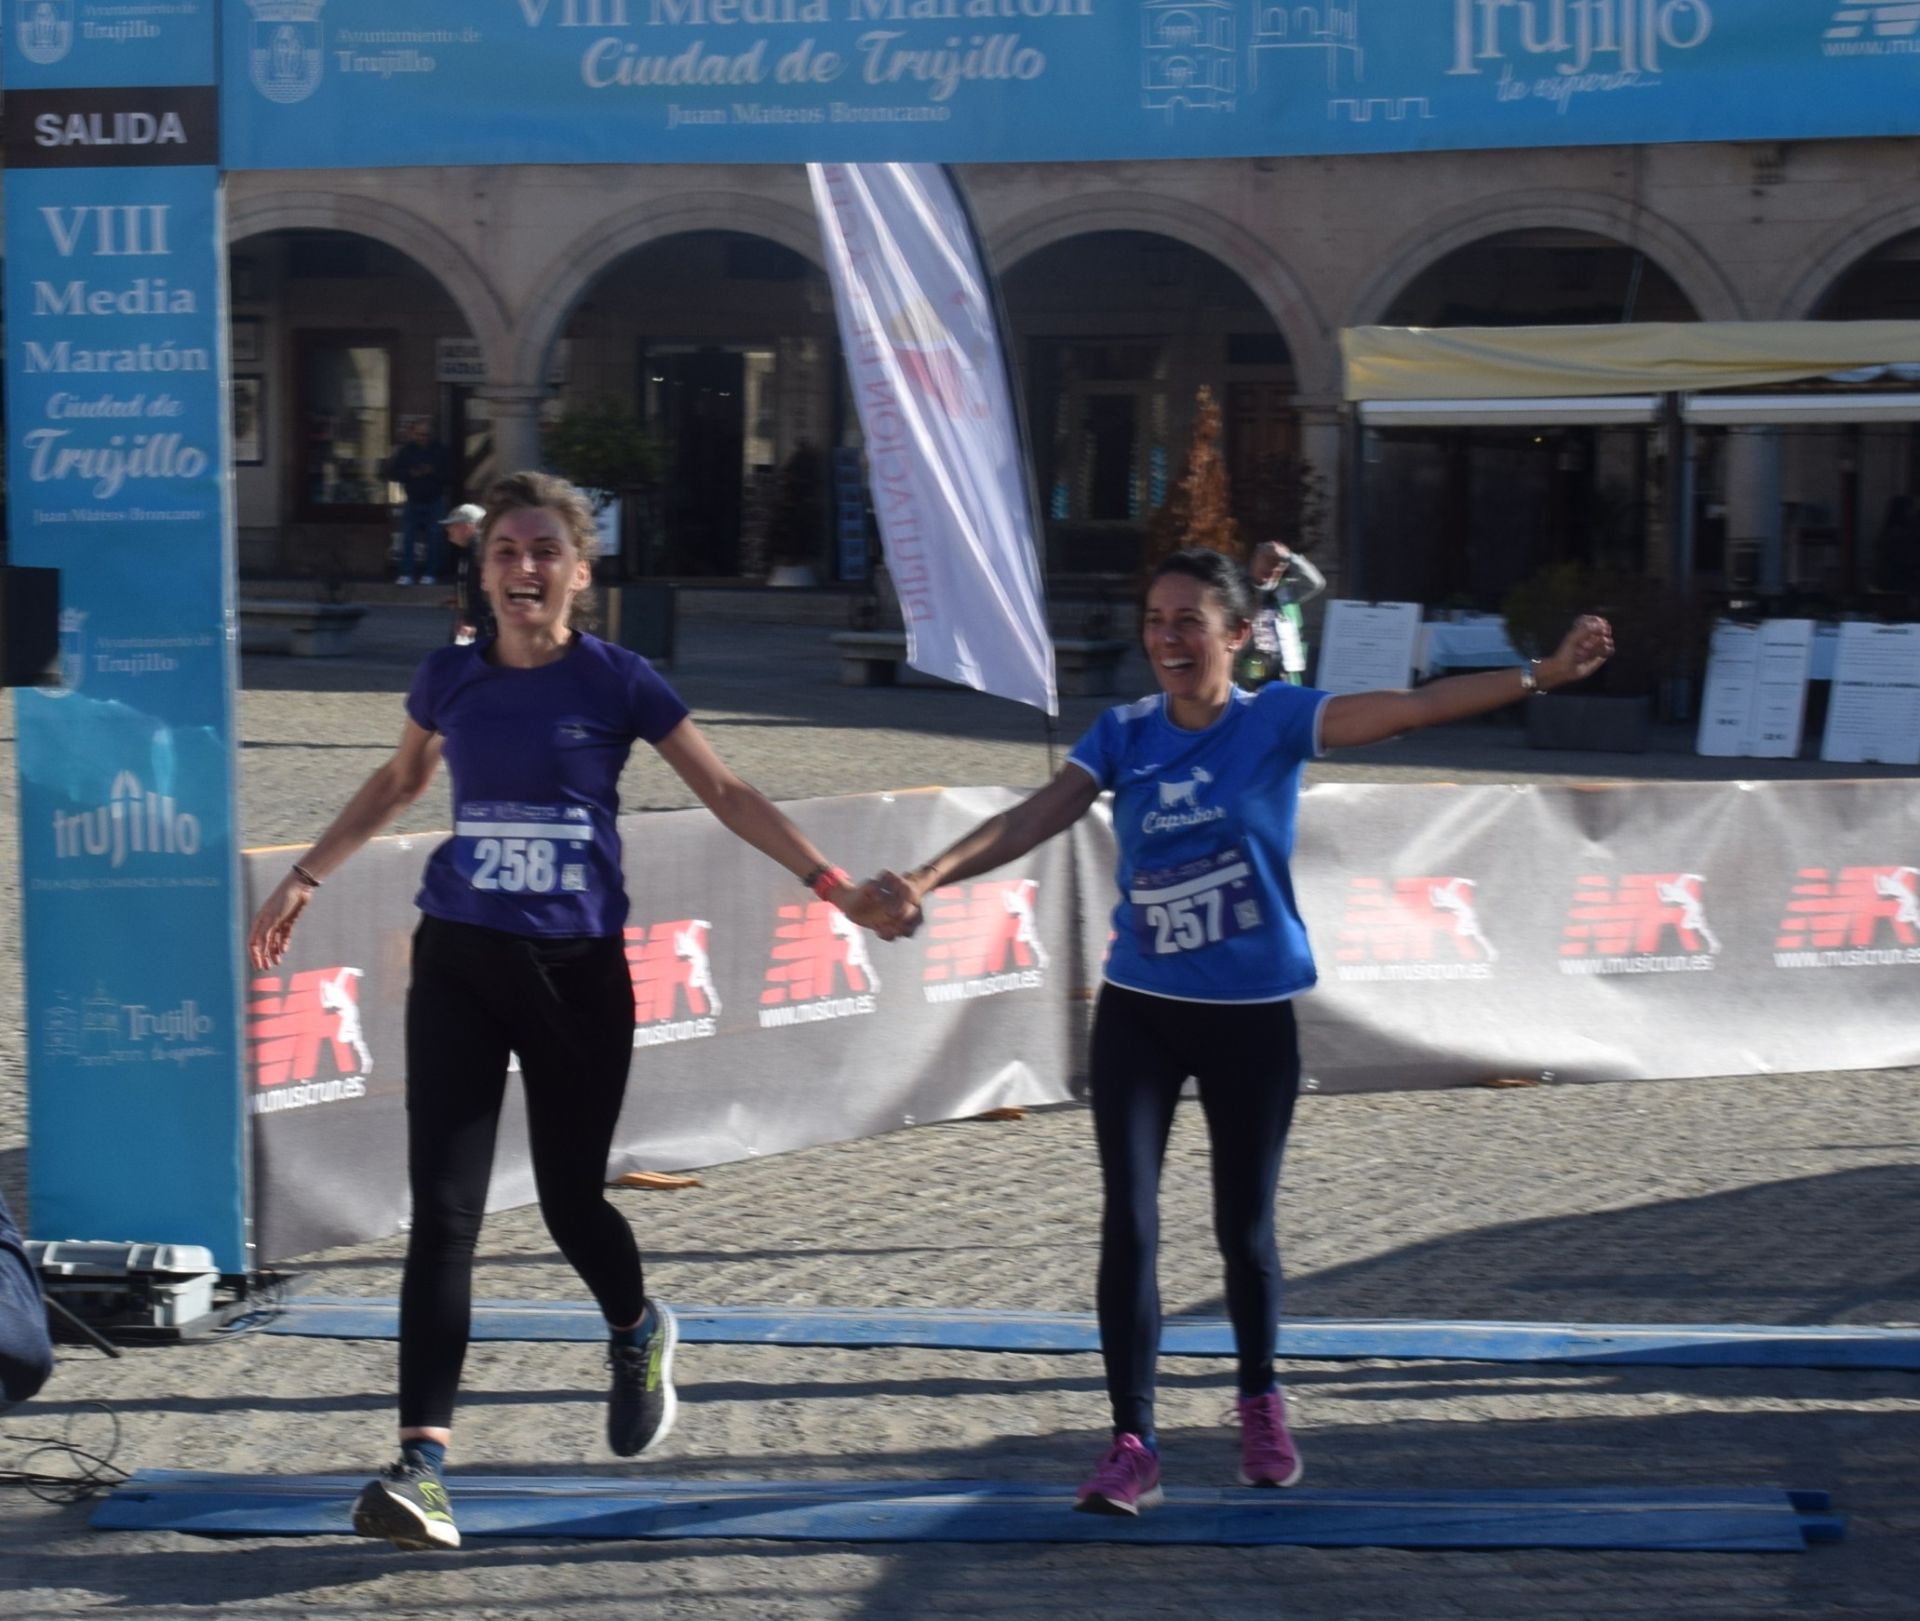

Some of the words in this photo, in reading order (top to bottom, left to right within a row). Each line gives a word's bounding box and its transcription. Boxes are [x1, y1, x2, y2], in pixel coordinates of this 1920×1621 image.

[518, 0, 631, 27] VIII
[645, 0, 831, 25] Media
[81, 20, 161, 43] Trujillo
[334, 49, 437, 79] Trujillo
[581, 37, 769, 88] Ciudad
[774, 39, 843, 84] de
[855, 30, 1046, 100] Trujillo
[35, 111, 187, 147] SALIDA
[666, 103, 727, 129] Juan
[731, 103, 824, 124] Mateos
[37, 205, 172, 257] VIII
[31, 278, 198, 316] Media
[22, 340, 209, 374] Maratón
[45, 391, 144, 420] Ciudad
[146, 393, 184, 418] de
[23, 428, 208, 499] Trujillo
[91, 652, 180, 678] Trujillo
[471, 837, 557, 893] 258
[1146, 888, 1224, 954] 257
